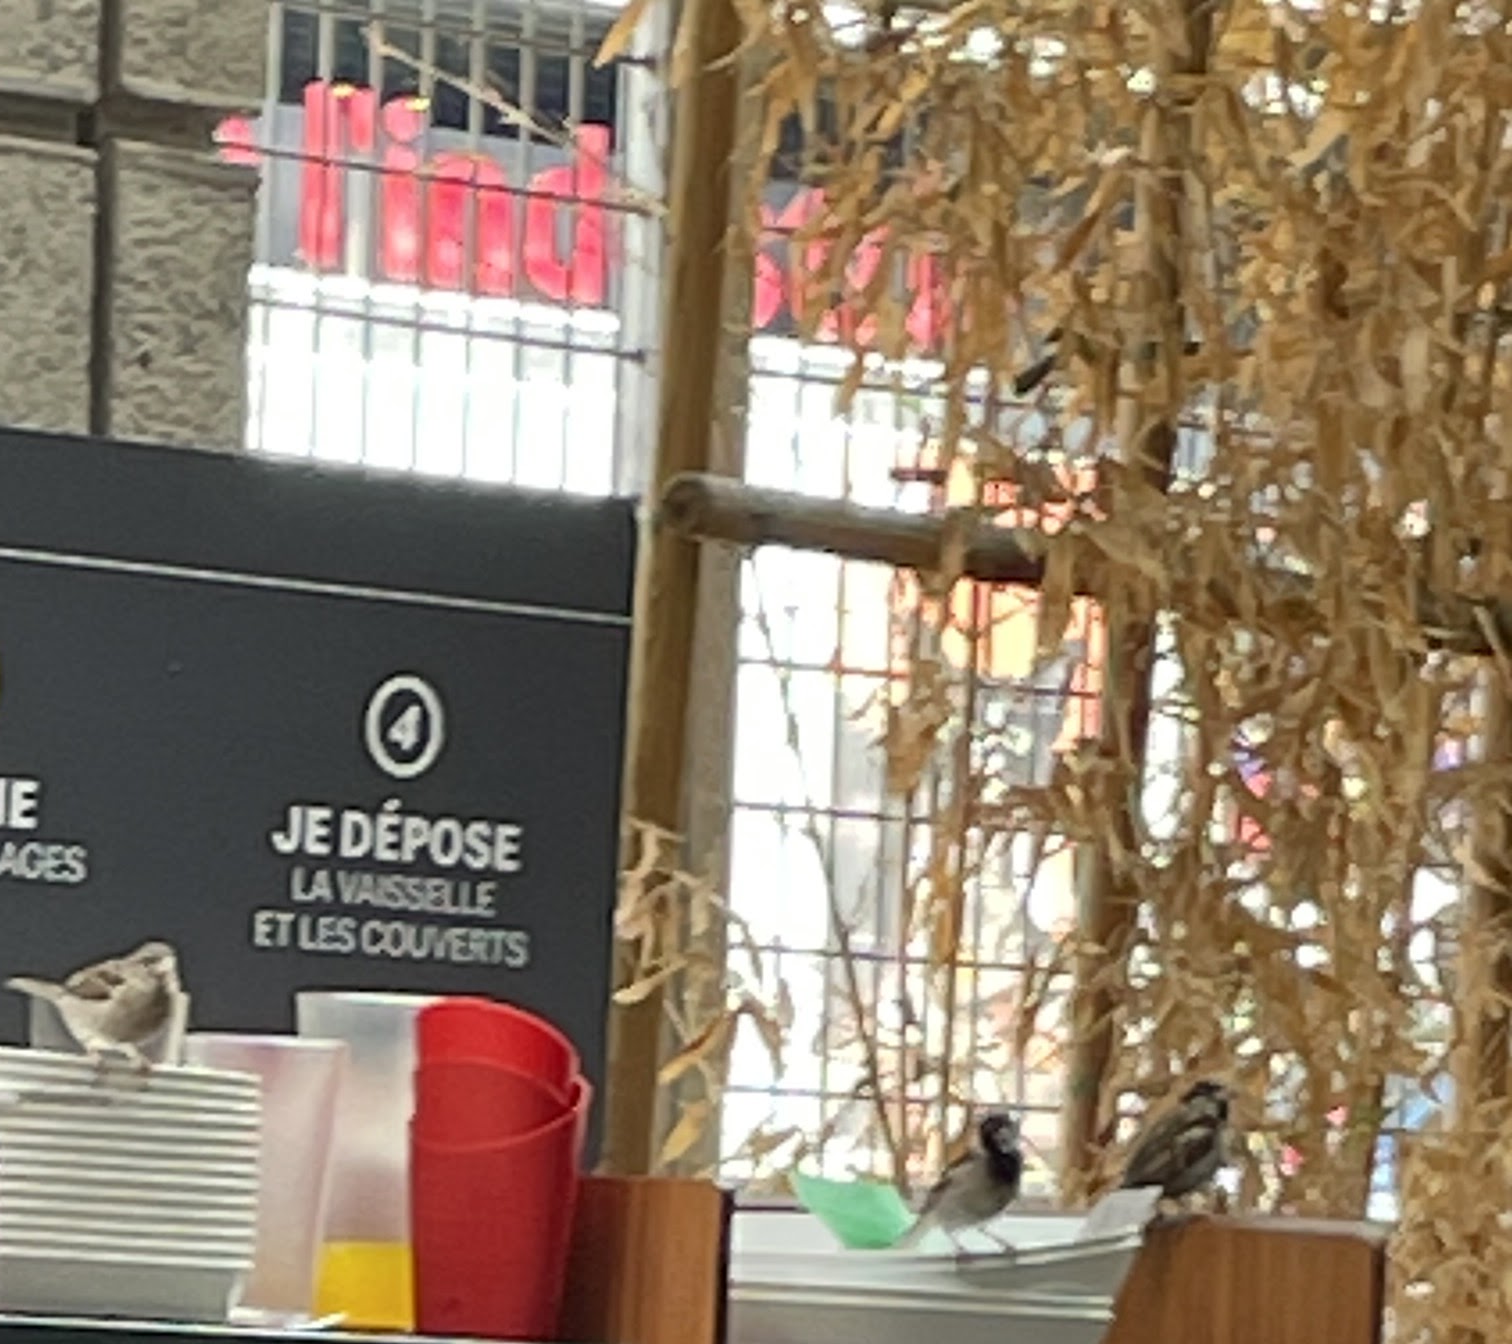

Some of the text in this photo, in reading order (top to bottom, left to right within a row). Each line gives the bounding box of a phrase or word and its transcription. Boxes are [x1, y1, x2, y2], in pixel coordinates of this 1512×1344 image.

[271, 798, 524, 873] JE DÉPOSE
[291, 865, 499, 918] LA VAISSELLE
[253, 909, 531, 969] ET LES COUVERTS
